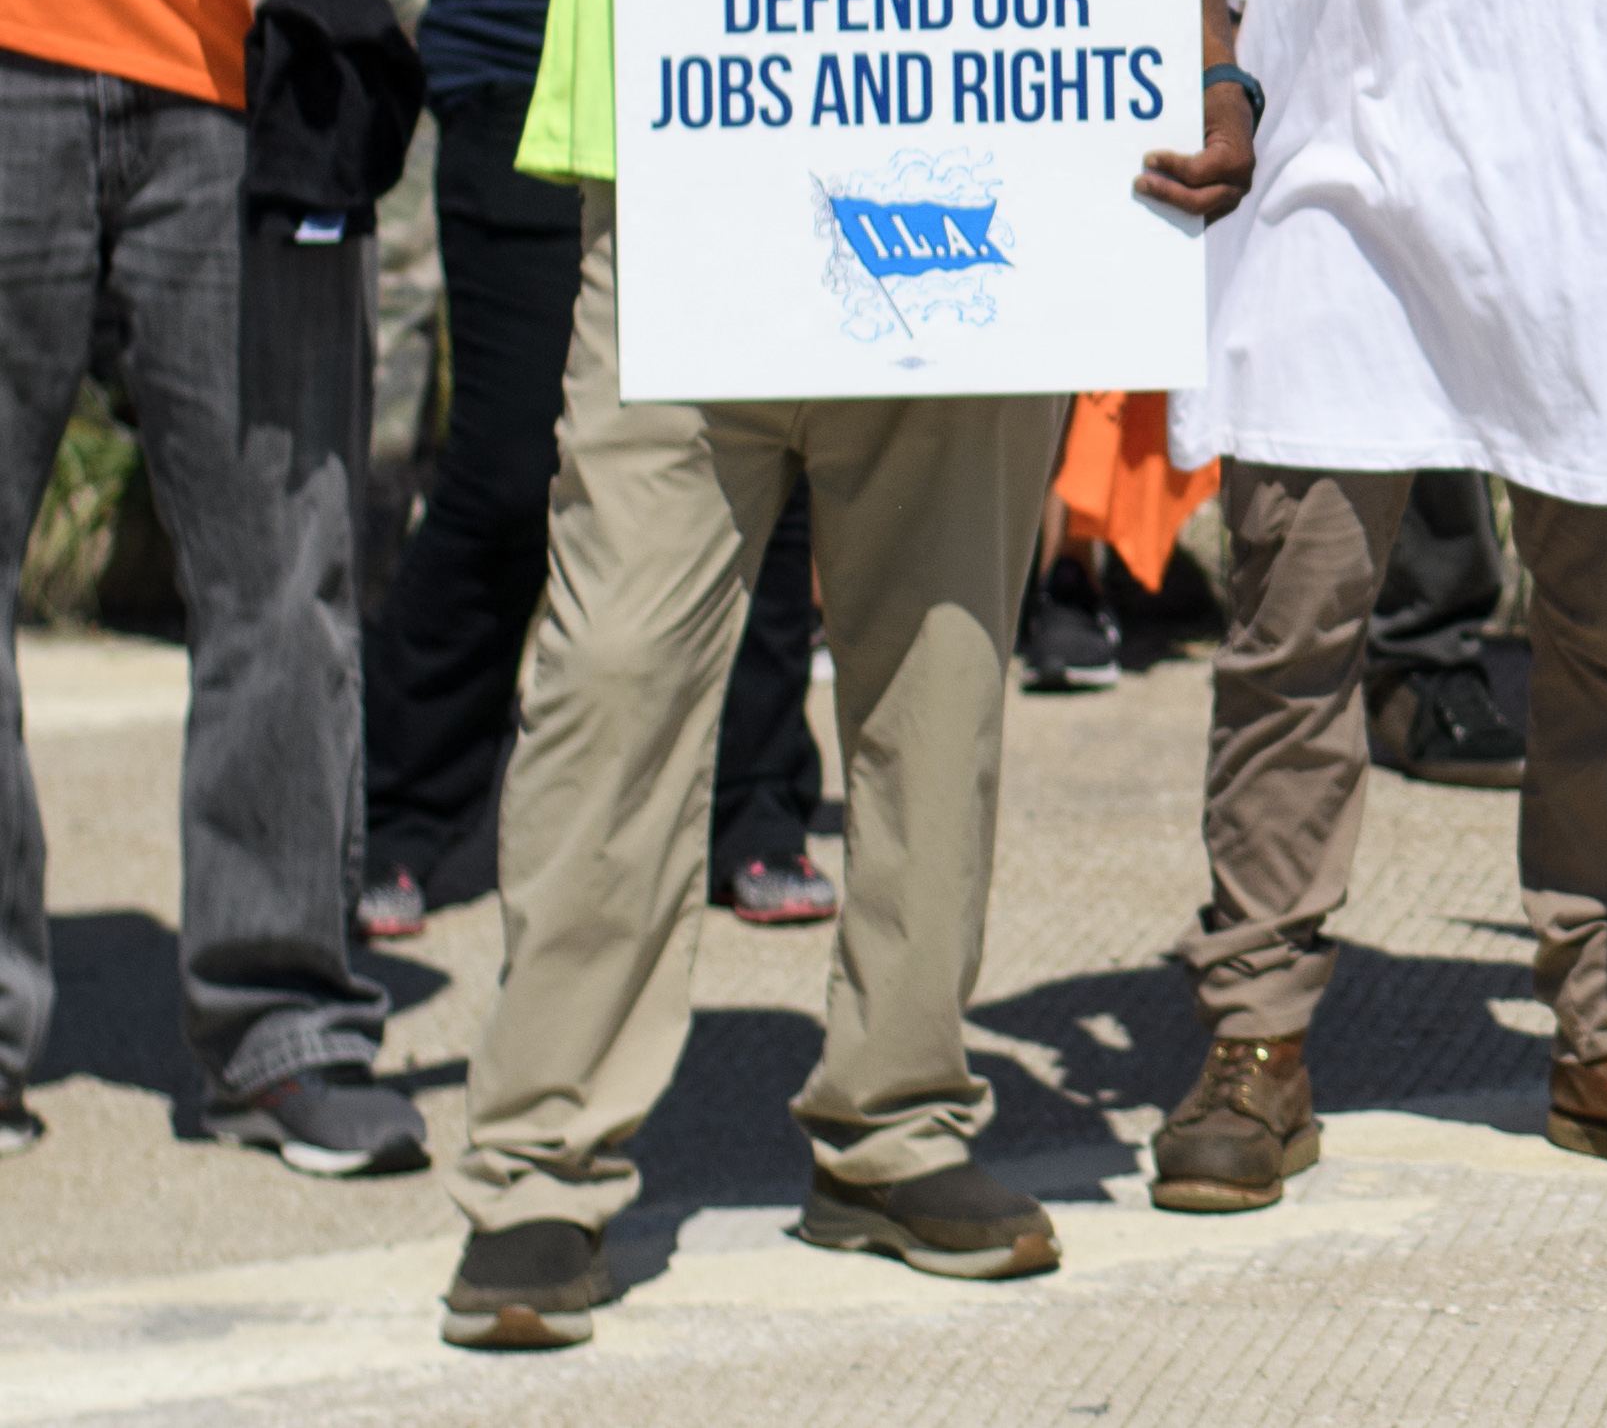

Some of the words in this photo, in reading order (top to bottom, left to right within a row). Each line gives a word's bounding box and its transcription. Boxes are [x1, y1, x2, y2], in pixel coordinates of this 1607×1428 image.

[651, 52, 794, 132] JOBS
[809, 50, 934, 128] AND
[951, 45, 1165, 126] RIGHTS
[855, 210, 992, 260] I.L.A.
